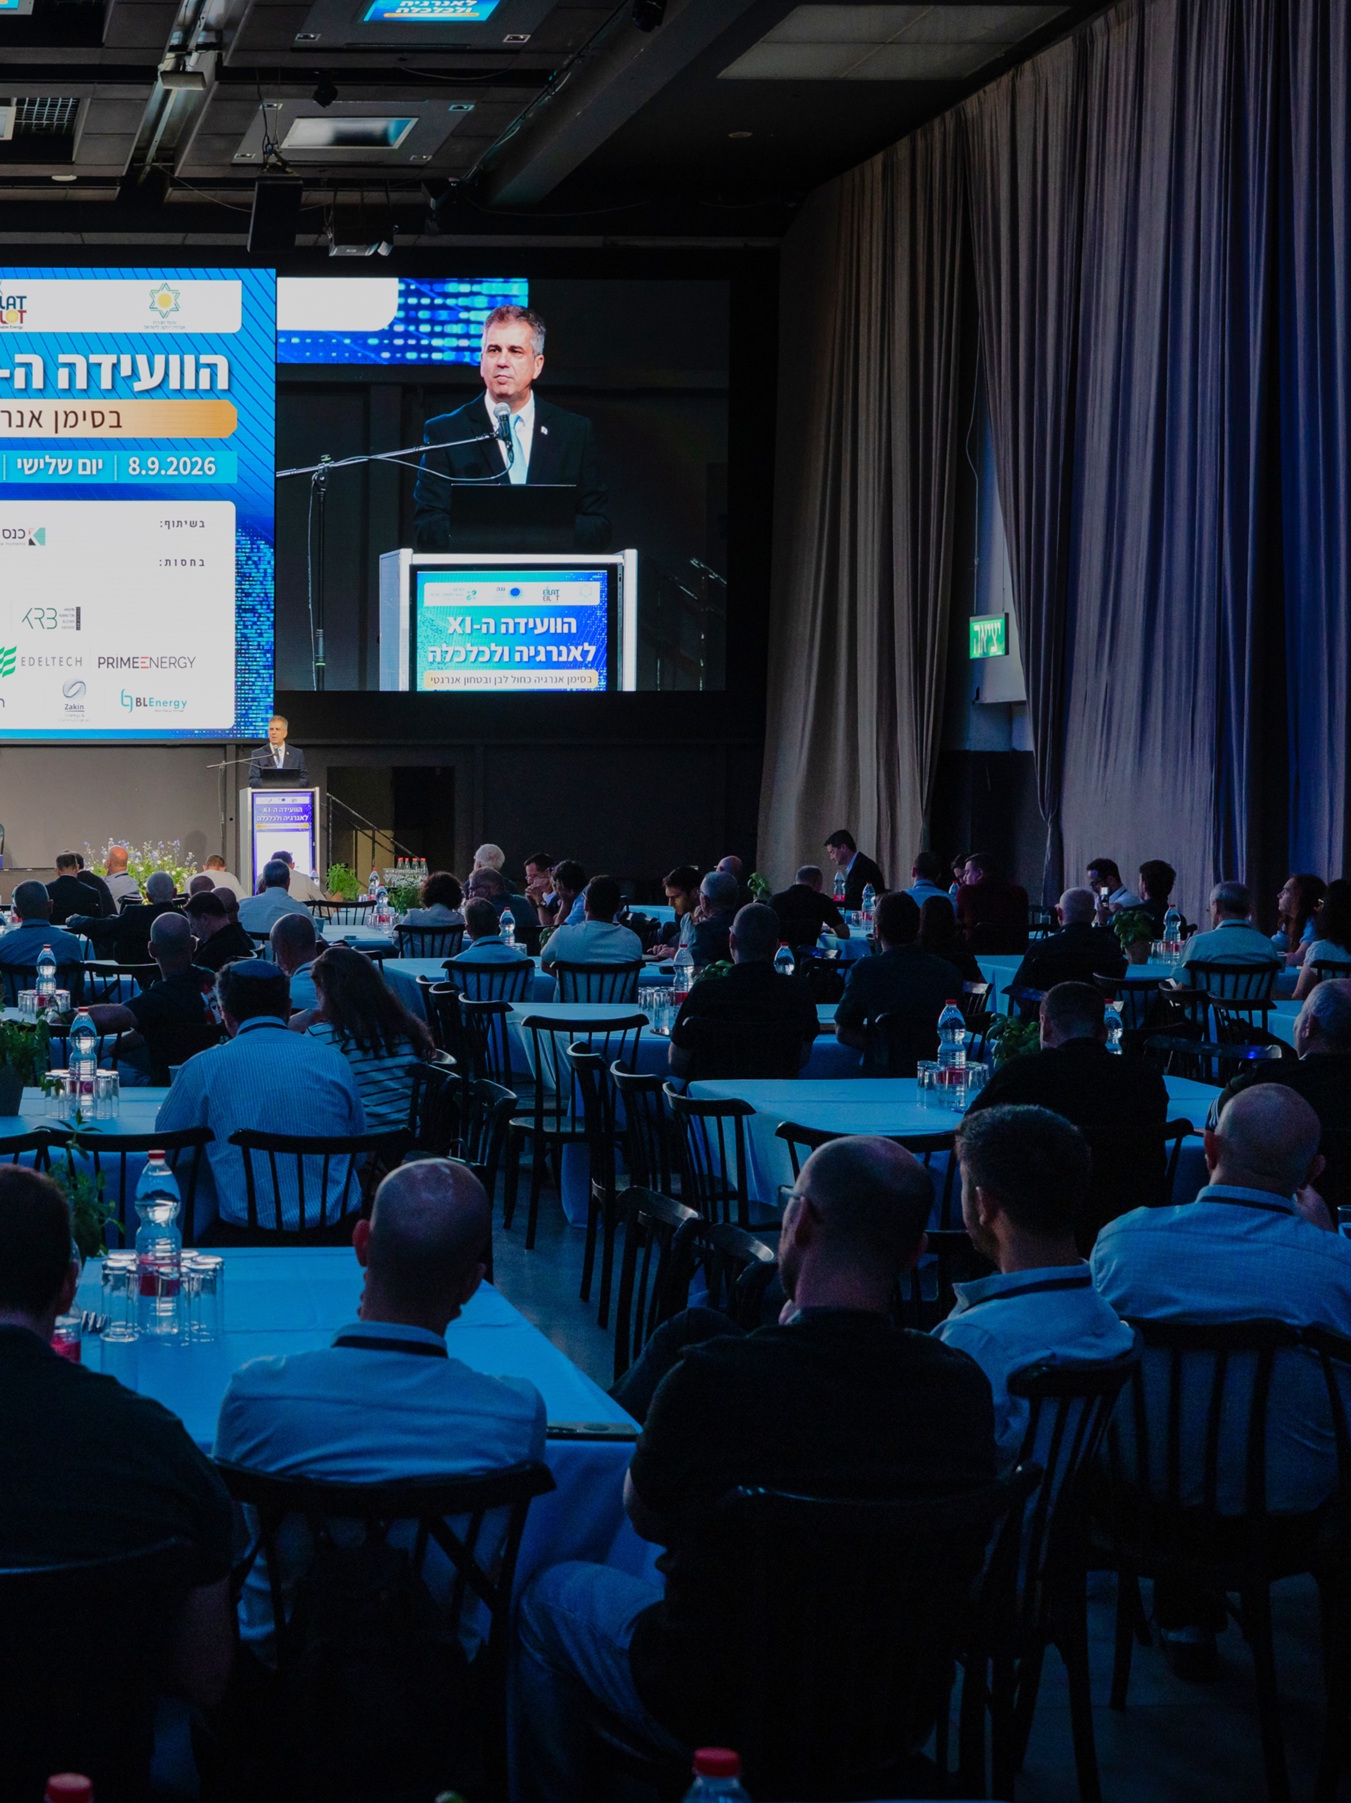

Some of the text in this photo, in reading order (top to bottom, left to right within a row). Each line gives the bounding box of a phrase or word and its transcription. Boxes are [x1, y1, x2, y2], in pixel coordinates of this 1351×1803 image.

[57, 353, 230, 392] הוועידה
[54, 409, 123, 434] בסימן
[16, 454, 73, 475] שלישי
[77, 457, 104, 476] יום
[127, 456, 217, 476] 8.9.2026
[159, 518, 206, 530] בשיתוף:
[2, 528, 27, 540] כנס
[158, 558, 206, 568] בחסות:
[21, 607, 58, 630] KRB
[500, 616, 578, 634] הוועידה
[973, 622, 1001, 655] יציאה
[20, 656, 83, 667] EDELTECH
[427, 642, 597, 663] לאנרגיה ולכלכלה
[430, 674, 593, 686] בסימן אנרגיה כחול לבן ובטחון אנרגטי
[64, 703, 85, 711] Zakin
